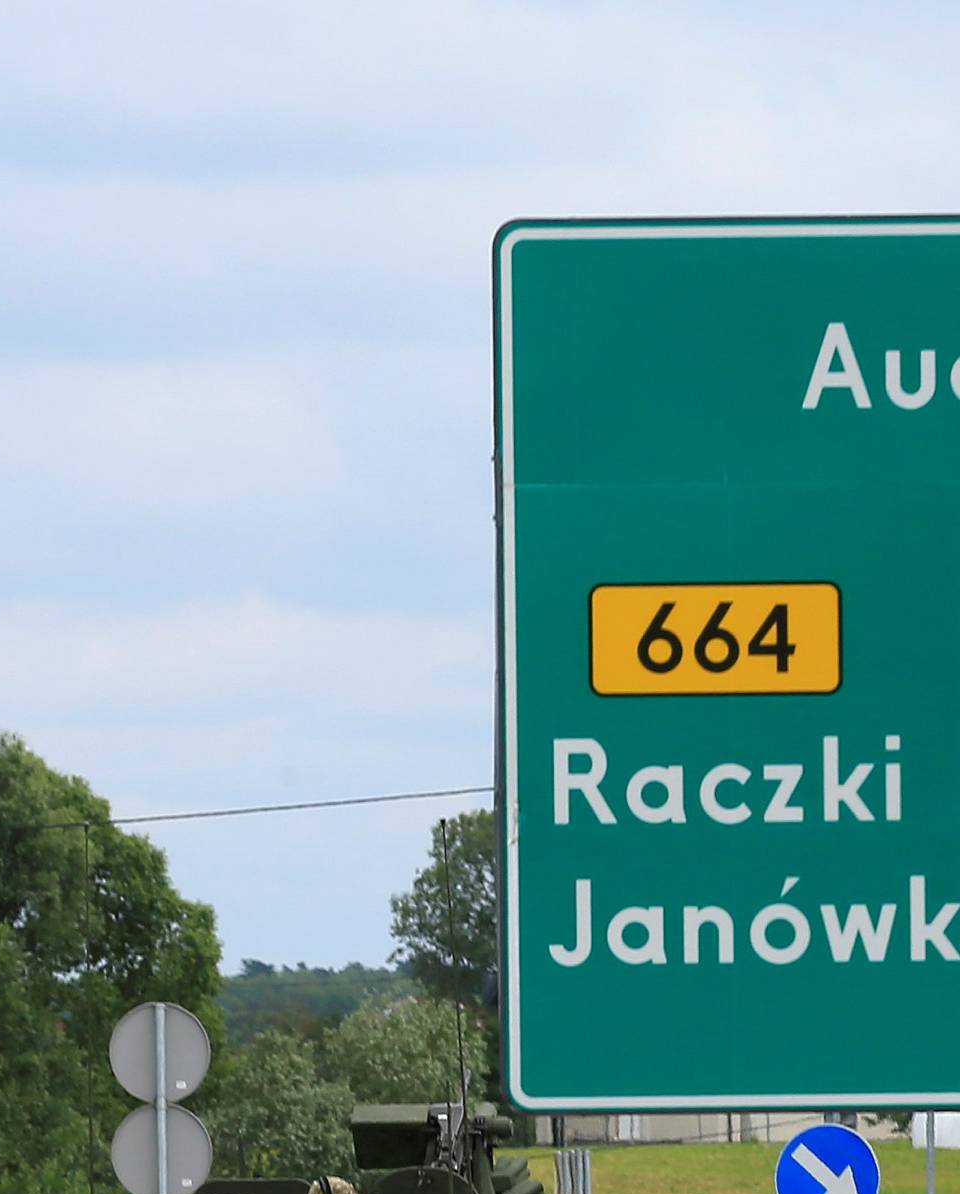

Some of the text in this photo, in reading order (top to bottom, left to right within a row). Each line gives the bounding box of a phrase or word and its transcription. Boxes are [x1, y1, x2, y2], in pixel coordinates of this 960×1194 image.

[802, 322, 960, 410] Au
[637, 601, 797, 674] 664
[553, 735, 902, 824] Raczki
[549, 875, 960, 967] Janówk
